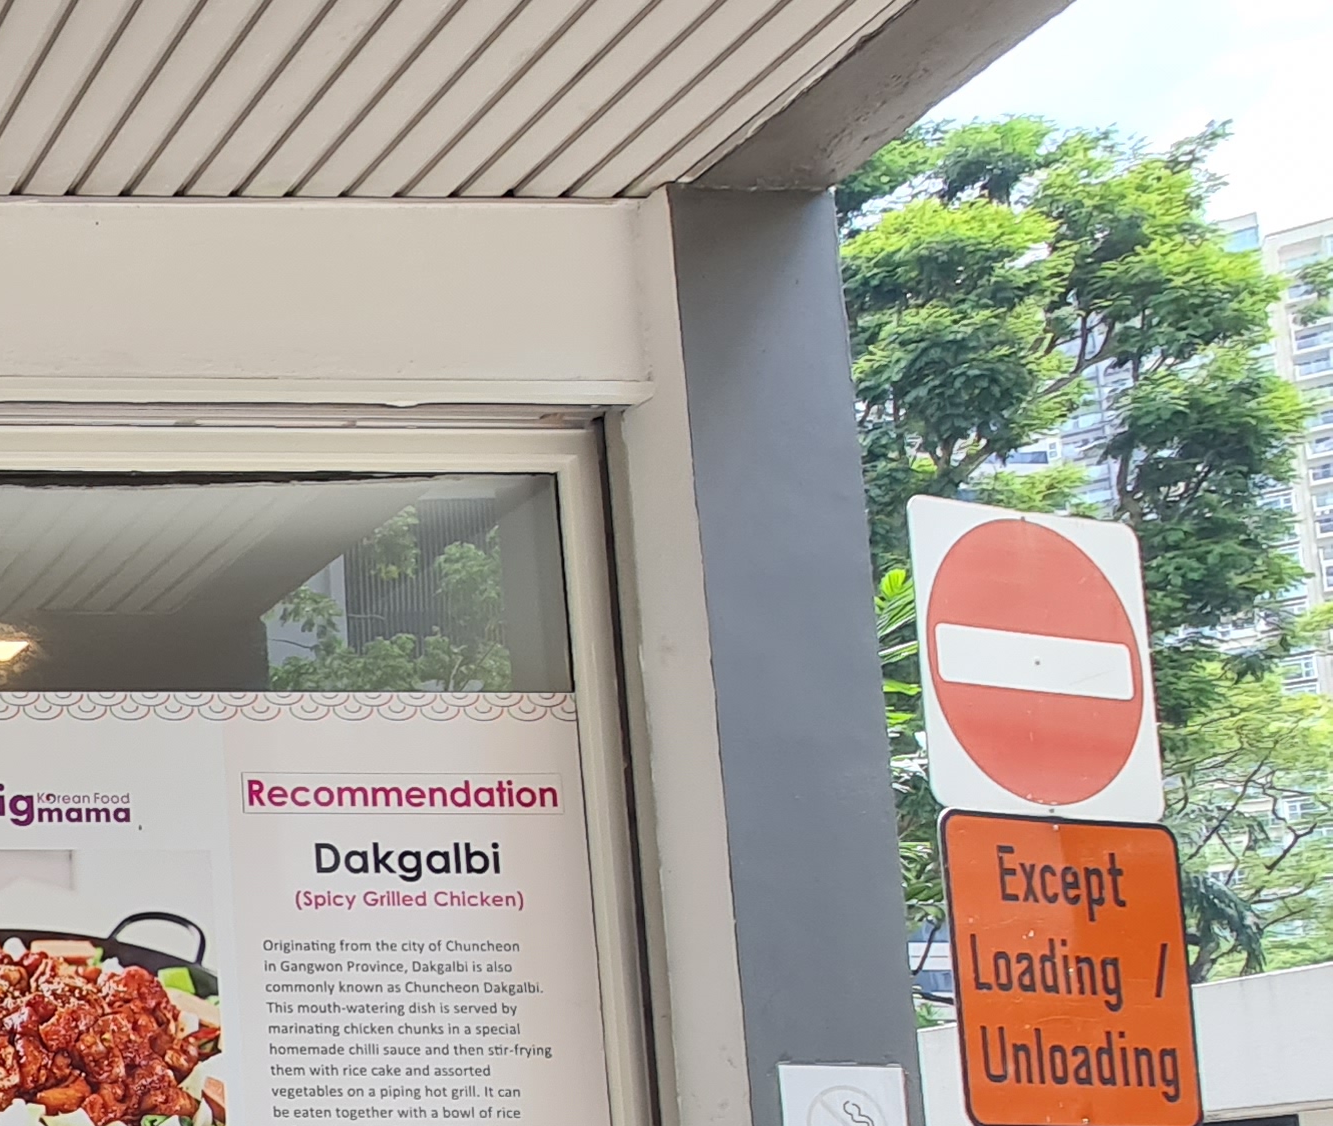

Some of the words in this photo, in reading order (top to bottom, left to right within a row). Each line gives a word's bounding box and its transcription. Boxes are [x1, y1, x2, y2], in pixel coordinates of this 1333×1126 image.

[37, 793, 91, 804] Korean
[94, 793, 130, 804] Food
[247, 779, 559, 808] Recommendation
[314, 842, 501, 882] Dakgalbi
[997, 844, 1127, 921] Except
[295, 890, 357, 911] (Spicy
[363, 891, 428, 907] Grilled
[433, 890, 525, 911] Chicken)
[263, 939, 336, 954] Originating
[339, 939, 372, 952] from
[375, 939, 397, 952] the
[401, 940, 425, 954] city
[428, 939, 442, 952] of
[445, 940, 520, 952] Chuncheon
[264, 960, 277, 972] in
[280, 960, 343, 975] Gangwon
[346, 960, 408, 974] Province,
[412, 960, 468, 975] Dakgalbi
[472, 961, 483, 973] is
[486, 961, 513, 973] also
[970, 933, 1123, 1012] Loading
[1155, 942, 1170, 998] /
[265, 980, 335, 995] commonly
[338, 980, 383, 993] known
[387, 984, 401, 993] as
[405, 981, 480, 993] Chuncheon
[483, 981, 544, 996] Dakgalbi.
[979, 1024, 1180, 1104] Unloading
